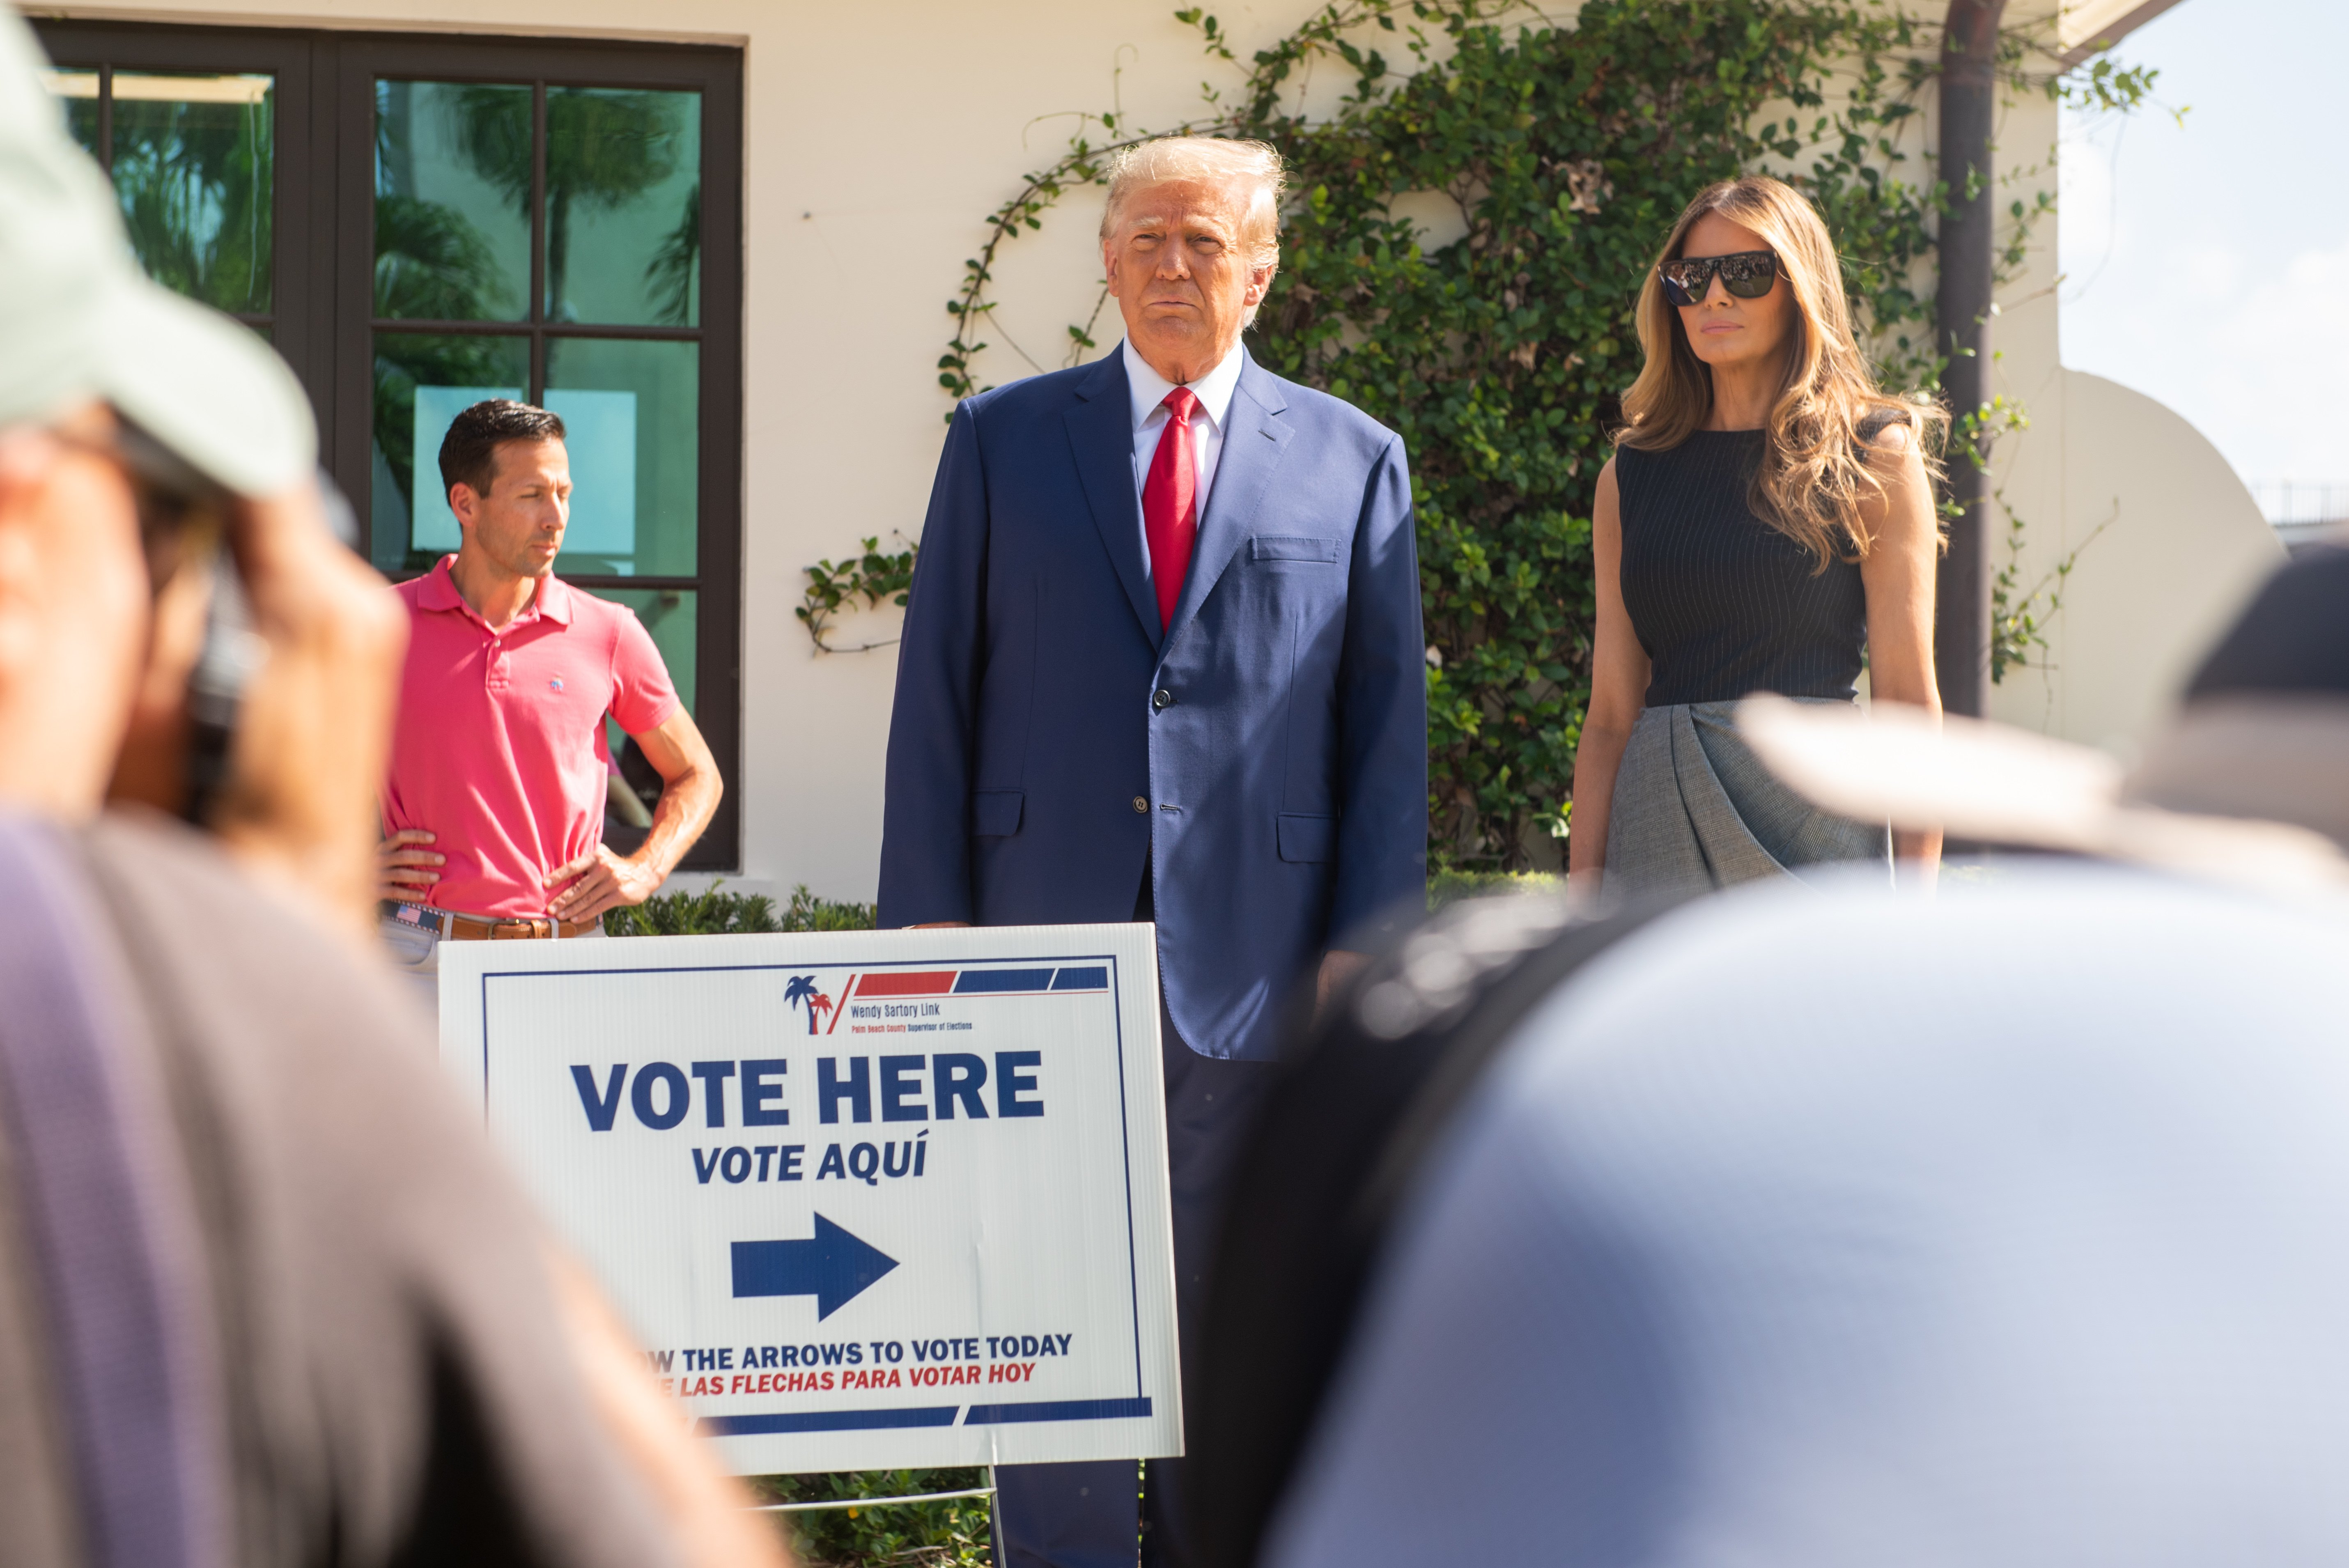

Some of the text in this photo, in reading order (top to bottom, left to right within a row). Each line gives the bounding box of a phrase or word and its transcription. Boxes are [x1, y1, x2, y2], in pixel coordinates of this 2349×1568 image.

[851, 1003, 939, 1019] Wendy Sartory Link
[908, 1024, 937, 1032] Supervisor
[570, 1051, 1044, 1132] VOTE HERE
[692, 1129, 929, 1186] VOTE AQUÍ
[682, 1348, 733, 1371] THE
[742, 1343, 863, 1368] ARROWS
[870, 1341, 903, 1363] TO
[912, 1338, 979, 1361] VOTE
[986, 1334, 1072, 1358] TODAY
[681, 1376, 723, 1396] LAS
[731, 1371, 834, 1394] FLECHAS
[842, 1369, 901, 1389] PARA
[909, 1366, 981, 1387] VOTAR
[989, 1363, 1036, 1383] HOY
